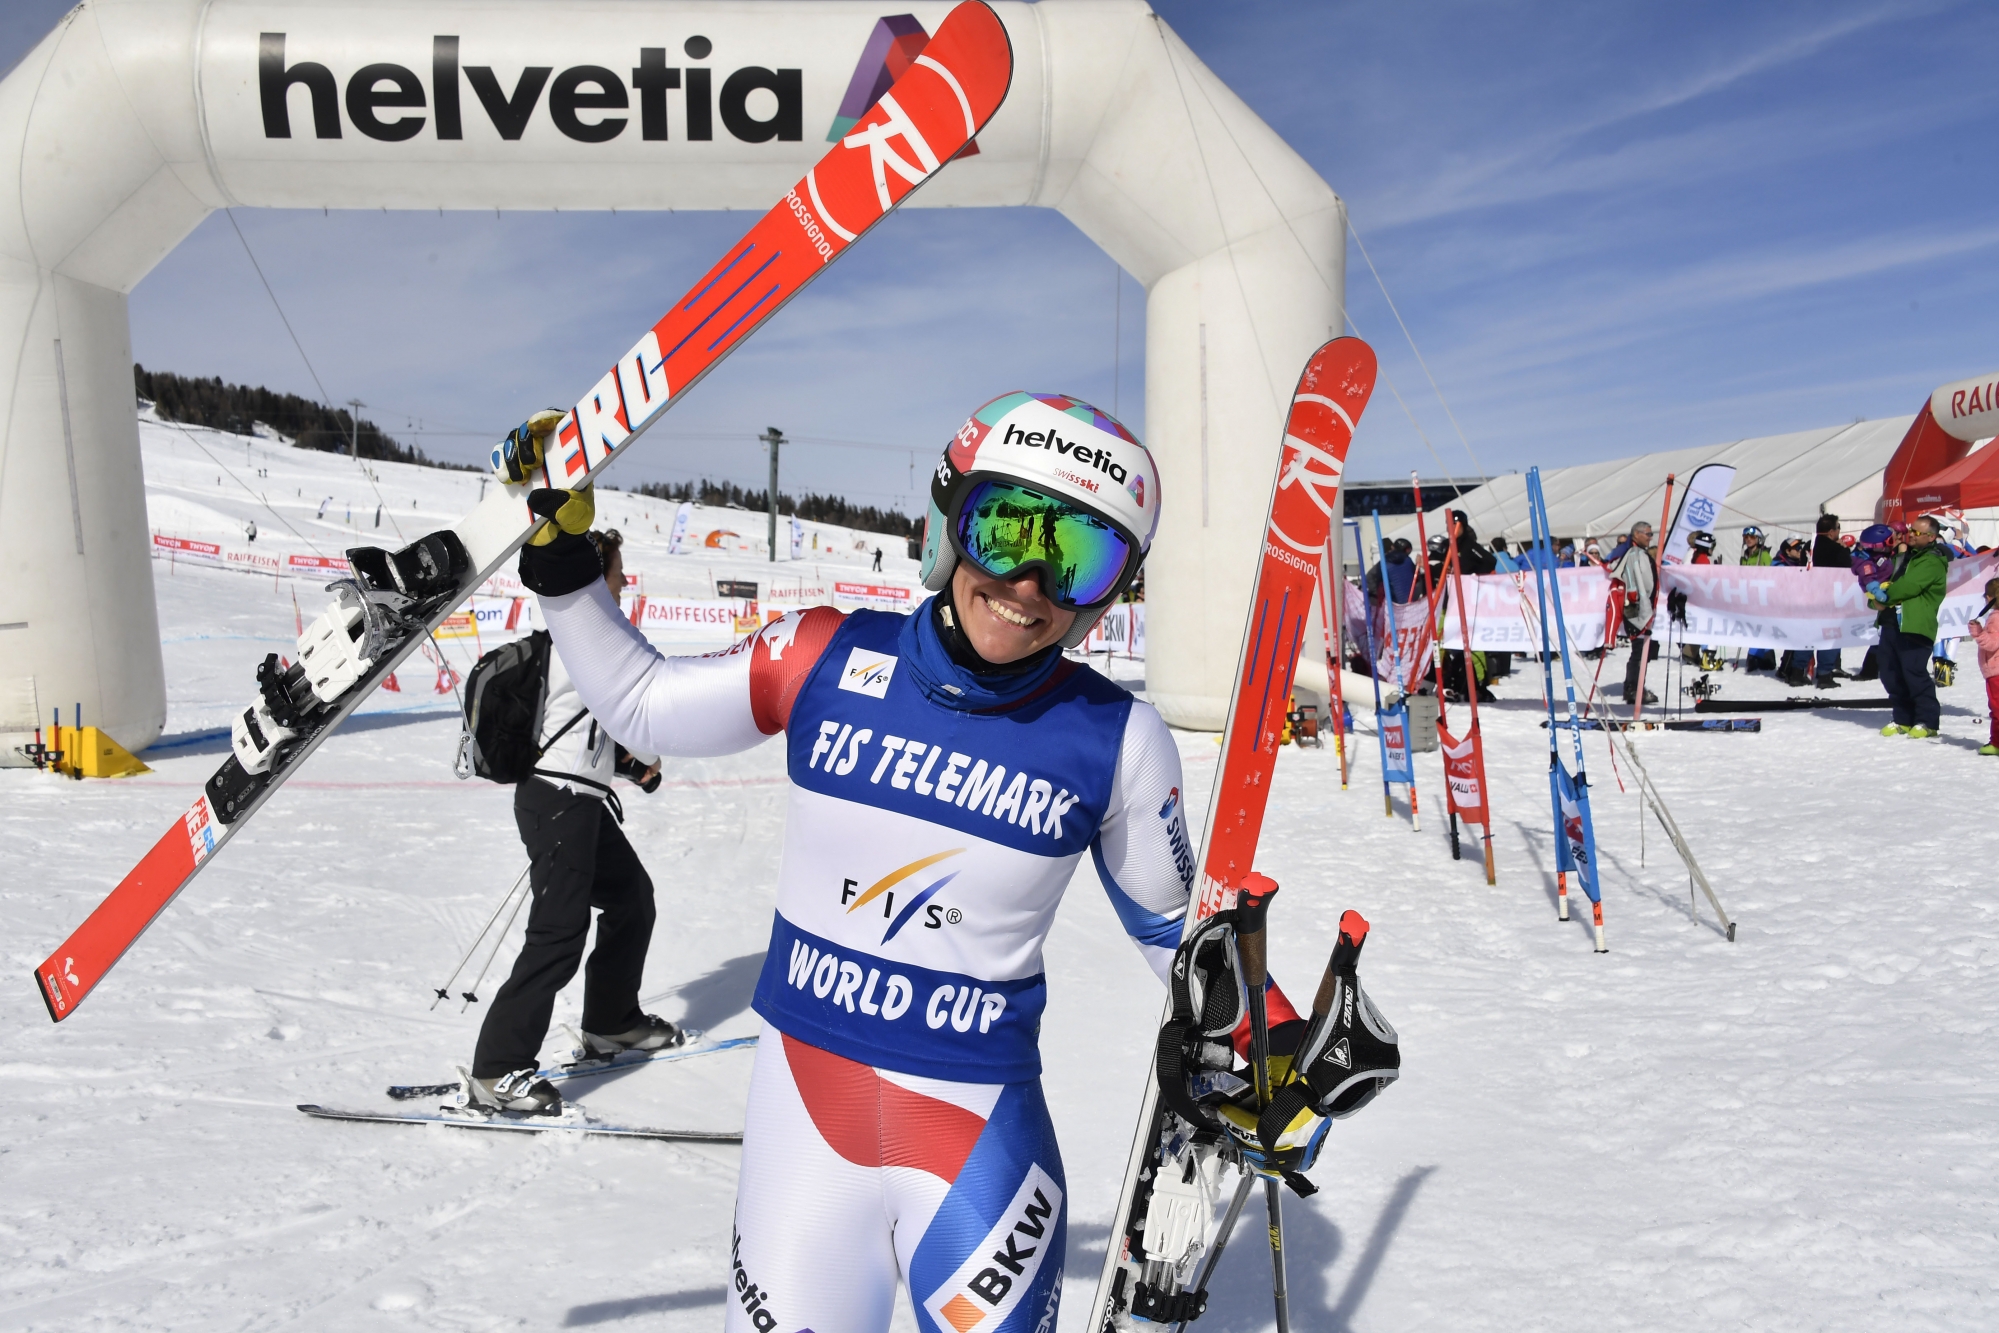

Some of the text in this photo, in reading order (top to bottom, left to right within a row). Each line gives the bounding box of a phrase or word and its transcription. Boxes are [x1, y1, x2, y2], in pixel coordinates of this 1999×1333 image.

[259, 32, 803, 142] helvetia
[785, 189, 834, 263] ROSSIGNOL
[1003, 424, 1128, 485] helvetia
[189, 542, 216, 553] THYON
[227, 552, 279, 567] RAIFFEISEN
[1265, 541, 1318, 579] ROSSIGNOL
[771, 587, 825, 599] RAIFFEISEN
[839, 584, 867, 594] THYON
[648, 604, 738, 623] RAIFFEISEN
[1104, 614, 1125, 642] BKW
[809, 719, 1080, 840] FIS TELEMARK
[192, 795, 215, 853] FIS GS
[787, 938, 1007, 1033] WORLD CUP
[967, 1187, 1053, 1307] BKW
